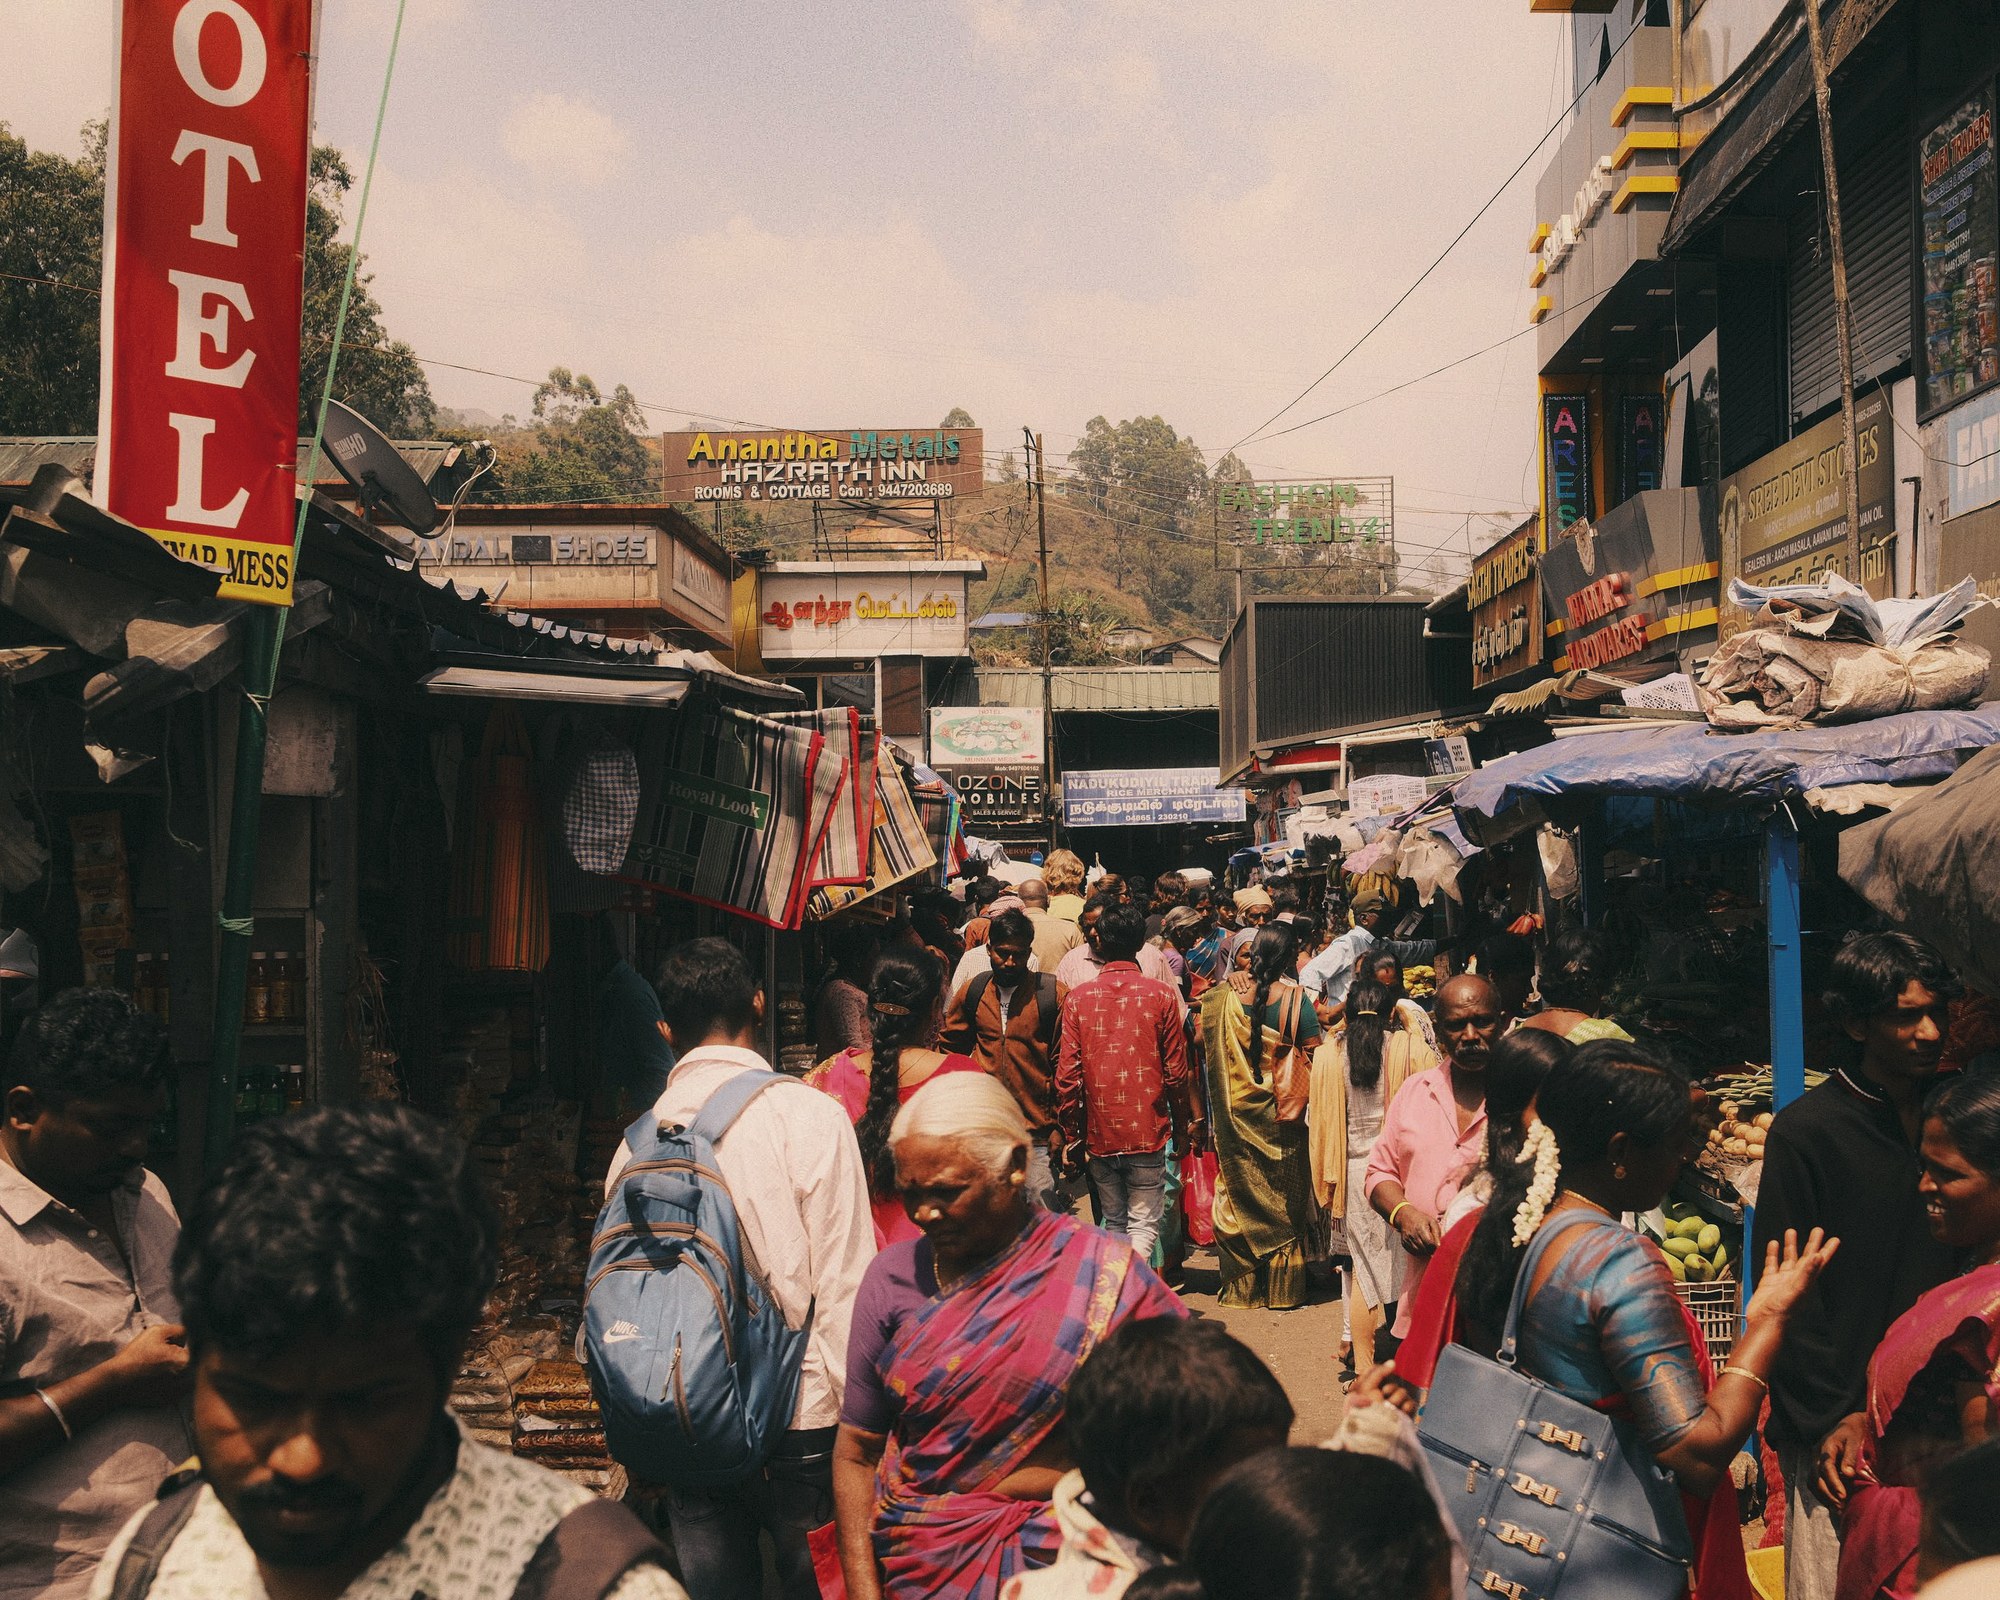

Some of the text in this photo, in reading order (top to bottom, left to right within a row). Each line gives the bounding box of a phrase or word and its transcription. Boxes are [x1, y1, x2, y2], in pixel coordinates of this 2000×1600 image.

[1950, 108, 1991, 168] TRADERS
[687, 430, 961, 461] Anantha Metals
[720, 460, 926, 484] HAZRATH INN
[1748, 424, 1879, 523] SREE DEVI STOES
[694, 485, 742, 500] ROOMS
[750, 486, 761, 499] &
[769, 485, 830, 499] COTTAGE
[878, 483, 953, 498] 9447203689
[1218, 482, 1357, 512] FASHION
[555, 536, 648, 560] SHOES
[1744, 555, 1767, 574] DEALERS
[1774, 543, 1791, 566] AACHI
[1873, 505, 1884, 521] OIL
[225, 547, 289, 590] MESS
[1492, 539, 1529, 596] TRADERS
[763, 591, 957, 630] ஆனந்தா மெட்டல்ஸ்
[1565, 613, 1646, 671] HARDWARES
[957, 774, 1040, 790] OZONE
[1068, 777, 1167, 790] NADUKUDIYIL
[1106, 787, 1200, 797] RICE MERCHANT
[668, 781, 760, 819] Royal Look
[959, 793, 1041, 804] MOBILES
[1157, 813, 1189, 821] 230210
[611, 1319, 640, 1335] NIKE
